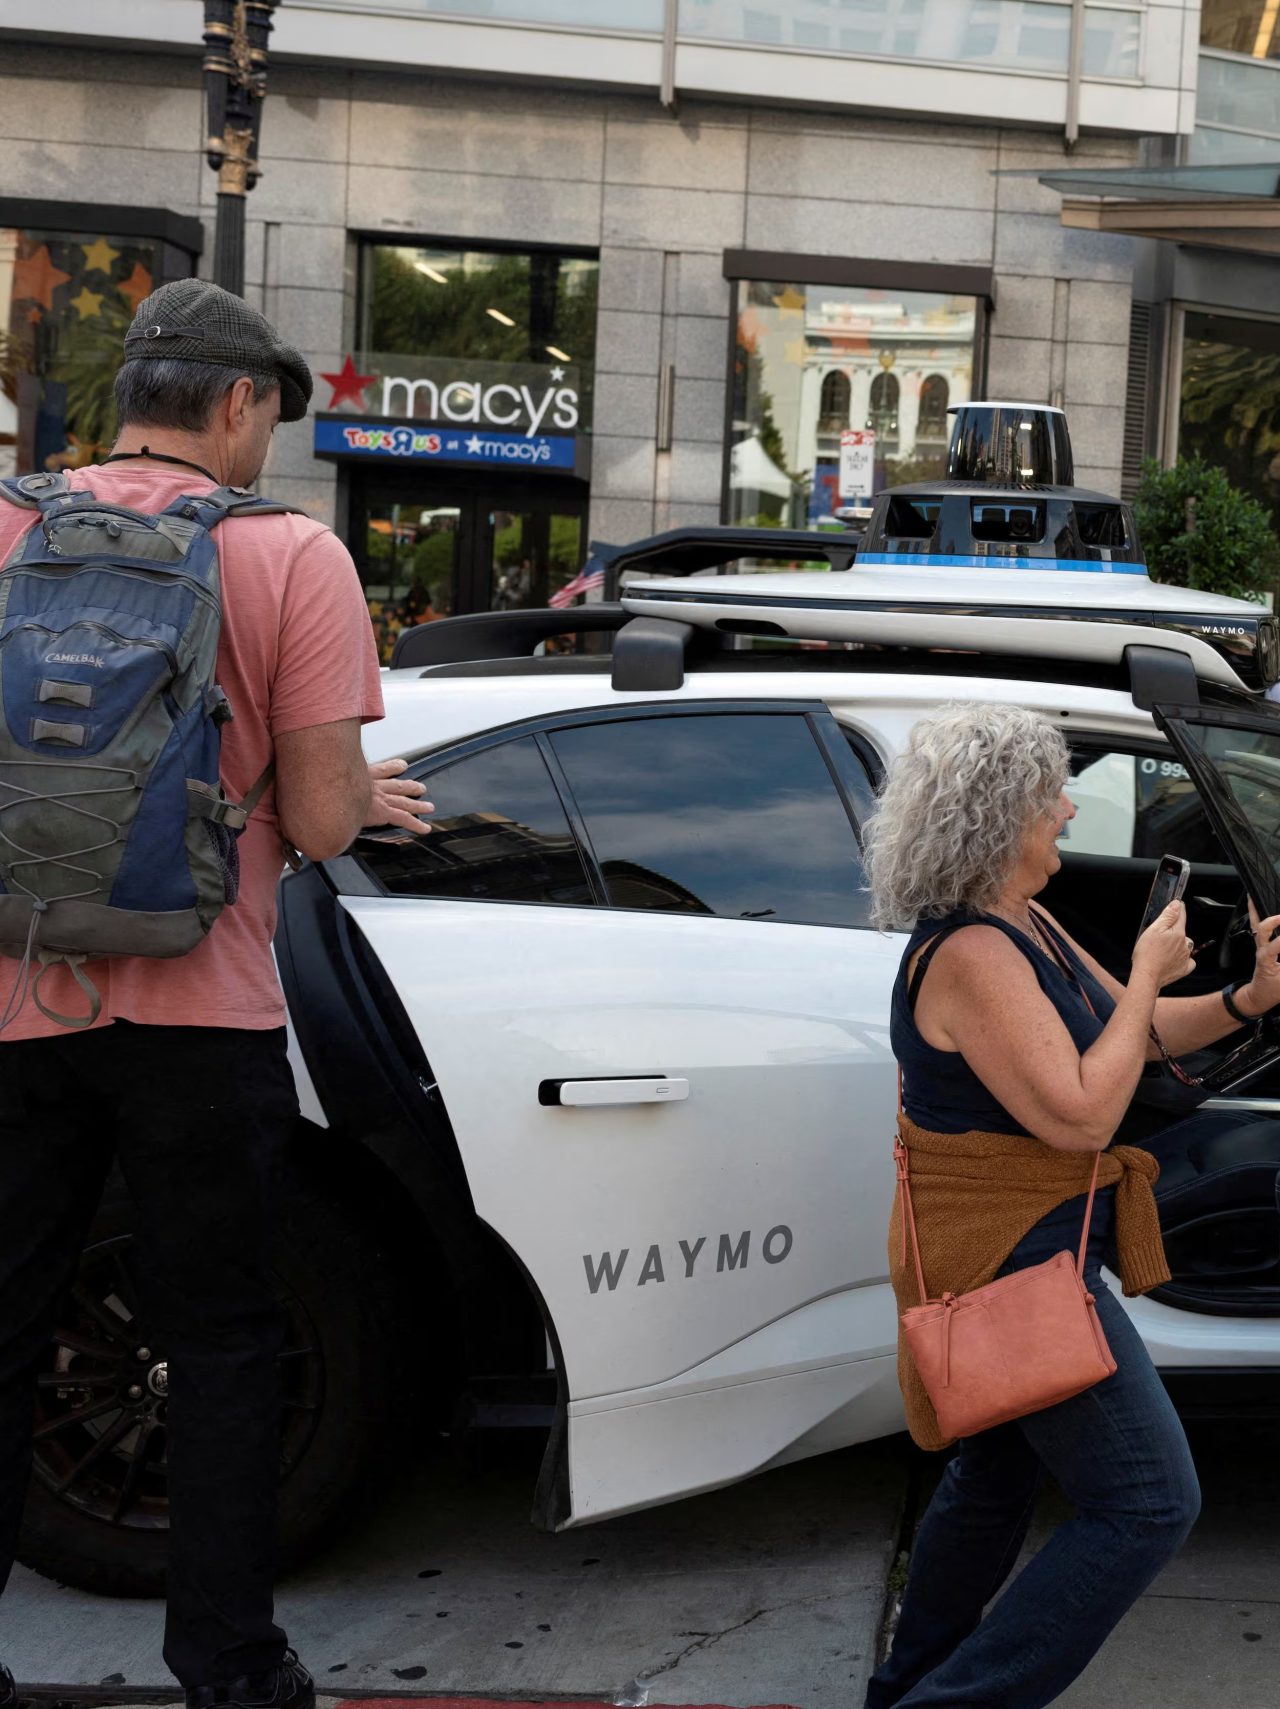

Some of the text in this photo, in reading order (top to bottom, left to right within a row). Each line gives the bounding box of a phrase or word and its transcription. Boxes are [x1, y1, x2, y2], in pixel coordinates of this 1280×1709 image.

[382, 366, 578, 438] macy's
[484, 438, 551, 463] macy's
[1201, 625, 1245, 635] WAYMO
[45, 652, 105, 669] CAMELBAK
[582, 1224, 793, 1294] WAYMO
